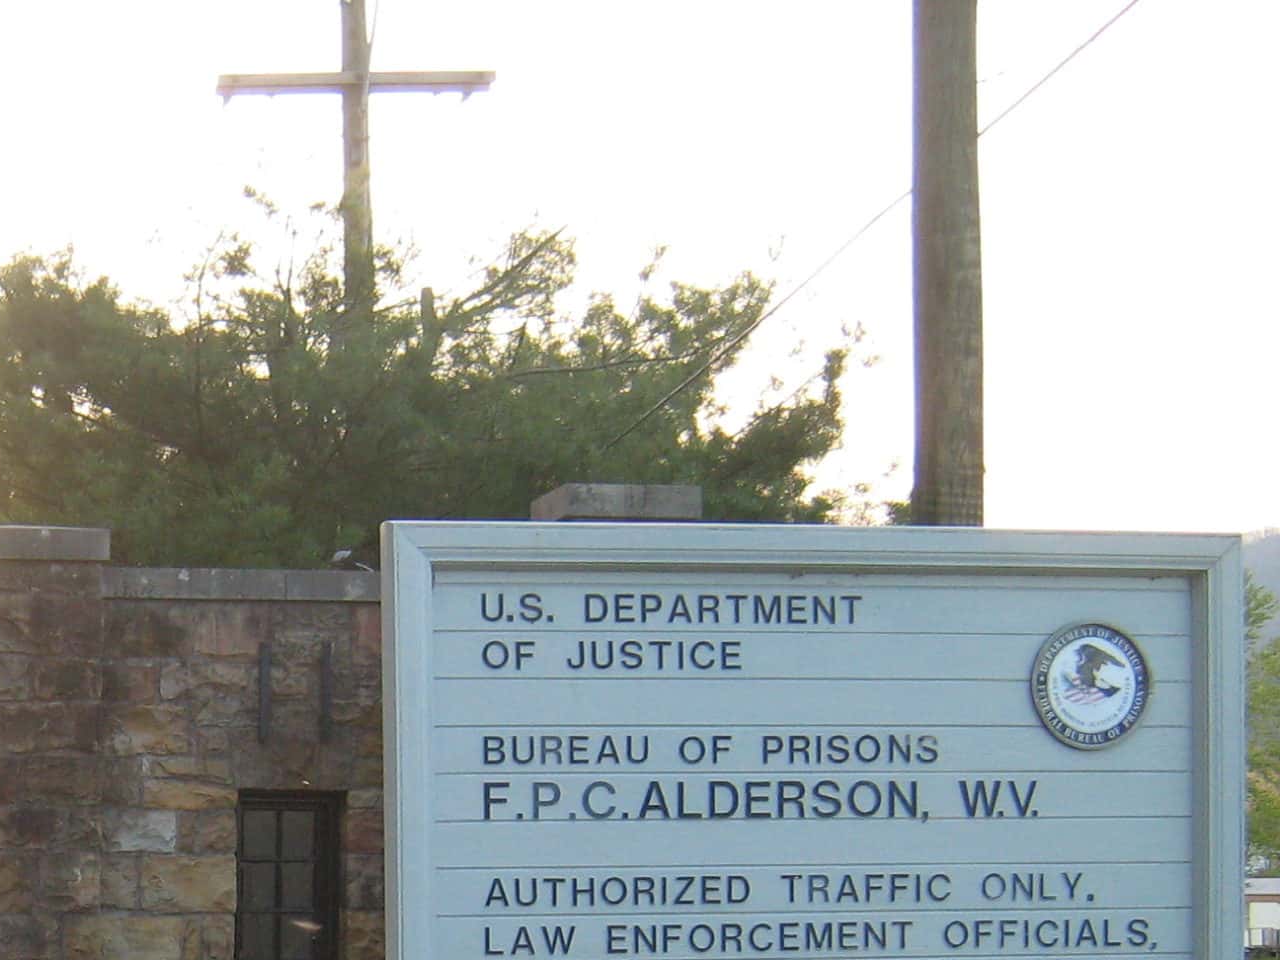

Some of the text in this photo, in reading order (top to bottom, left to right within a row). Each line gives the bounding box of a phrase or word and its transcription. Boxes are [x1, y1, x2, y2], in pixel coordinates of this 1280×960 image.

[480, 593, 863, 625] U.S. DEPARTMENT
[481, 640, 743, 671] OF JUSTICE
[482, 733, 939, 766] BUREAU OF PRISONS
[957, 780, 1039, 820] W.V.
[484, 872, 1095, 908] AUTHORIZED TRAFFIC ONLY.
[483, 918, 1159, 957] LAW ENFORCEMENT OFFICIALS,
